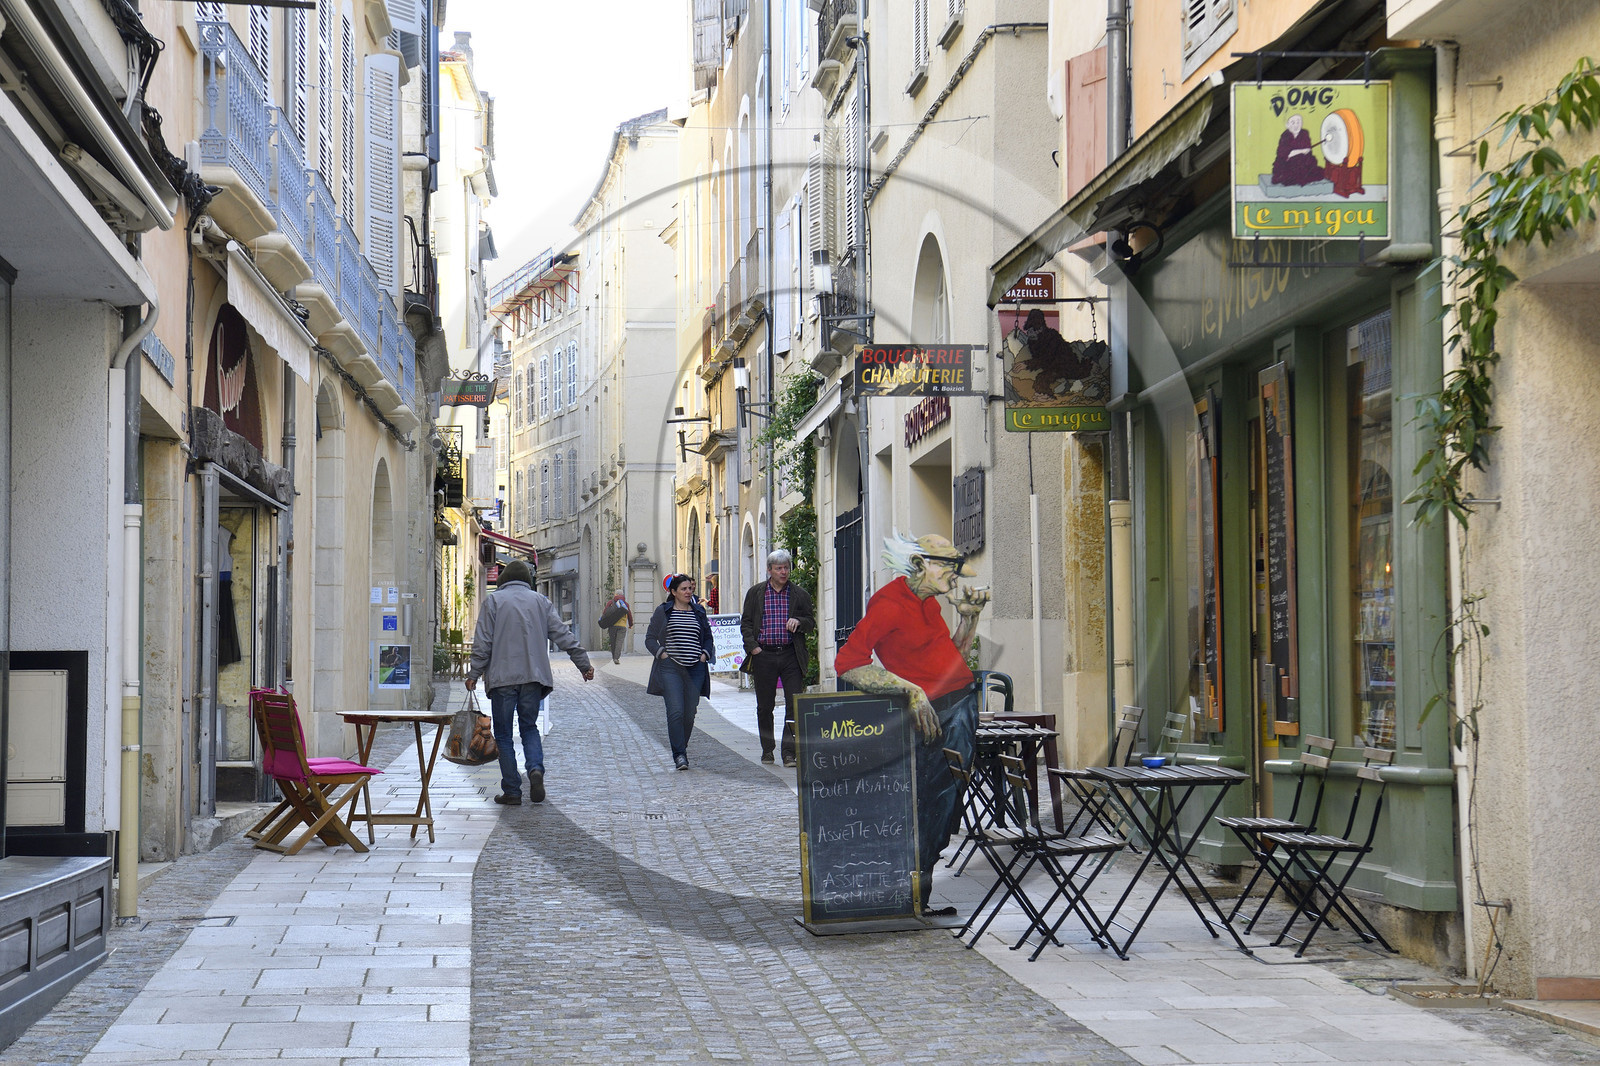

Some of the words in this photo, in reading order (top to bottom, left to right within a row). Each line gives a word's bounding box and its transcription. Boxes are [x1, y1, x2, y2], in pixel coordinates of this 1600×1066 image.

[1270, 87, 1334, 117] DONG
[1243, 205, 1288, 230] Le
[1283, 206, 1377, 236] migou
[1025, 277, 1042, 286] RUE
[862, 348, 965, 364] BOUCHERIE
[861, 368, 965, 384] CHARCUTERIE
[465, 384, 473, 392] DE
[443, 394, 487, 403] PATISSERIE
[1040, 411, 1105, 431] migou
